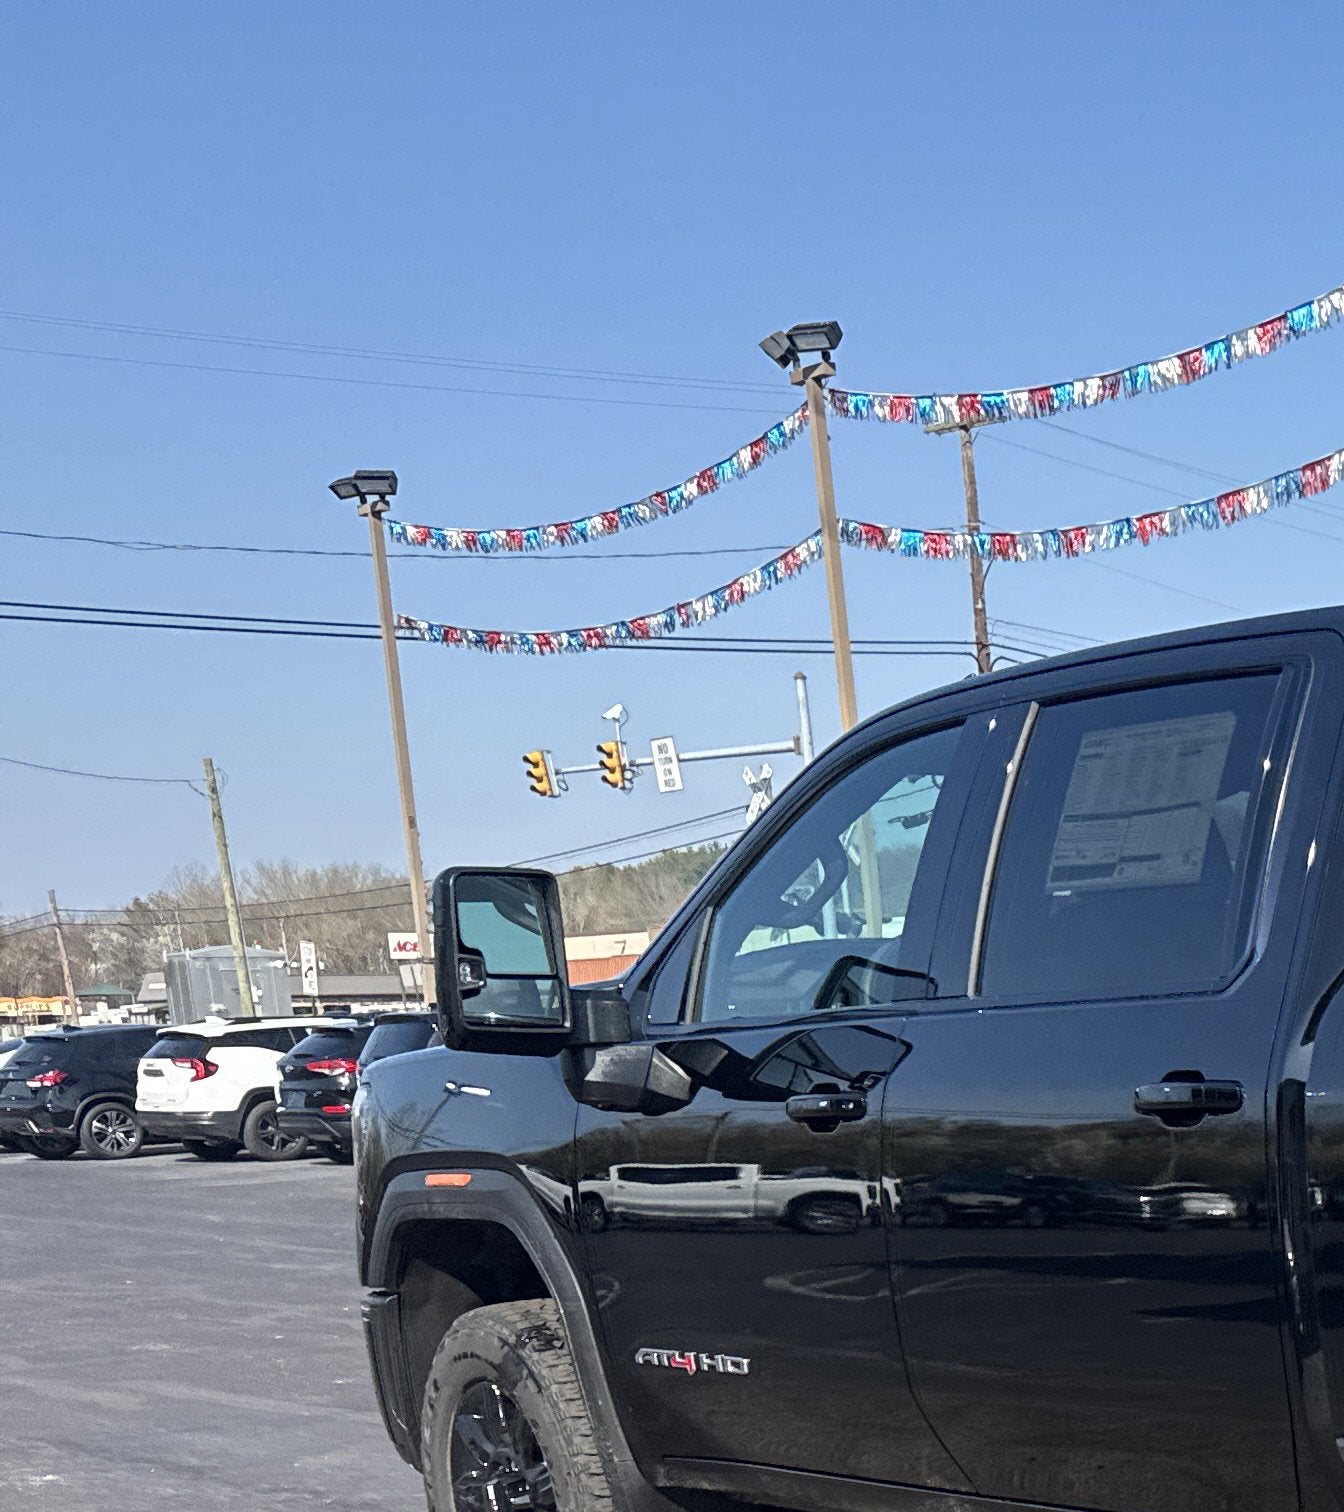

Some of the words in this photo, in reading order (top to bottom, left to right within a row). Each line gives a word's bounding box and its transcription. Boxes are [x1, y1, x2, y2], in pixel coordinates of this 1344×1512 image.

[657, 742, 669, 755] NO
[663, 767, 673, 777] ON
[664, 778, 676, 788] RED
